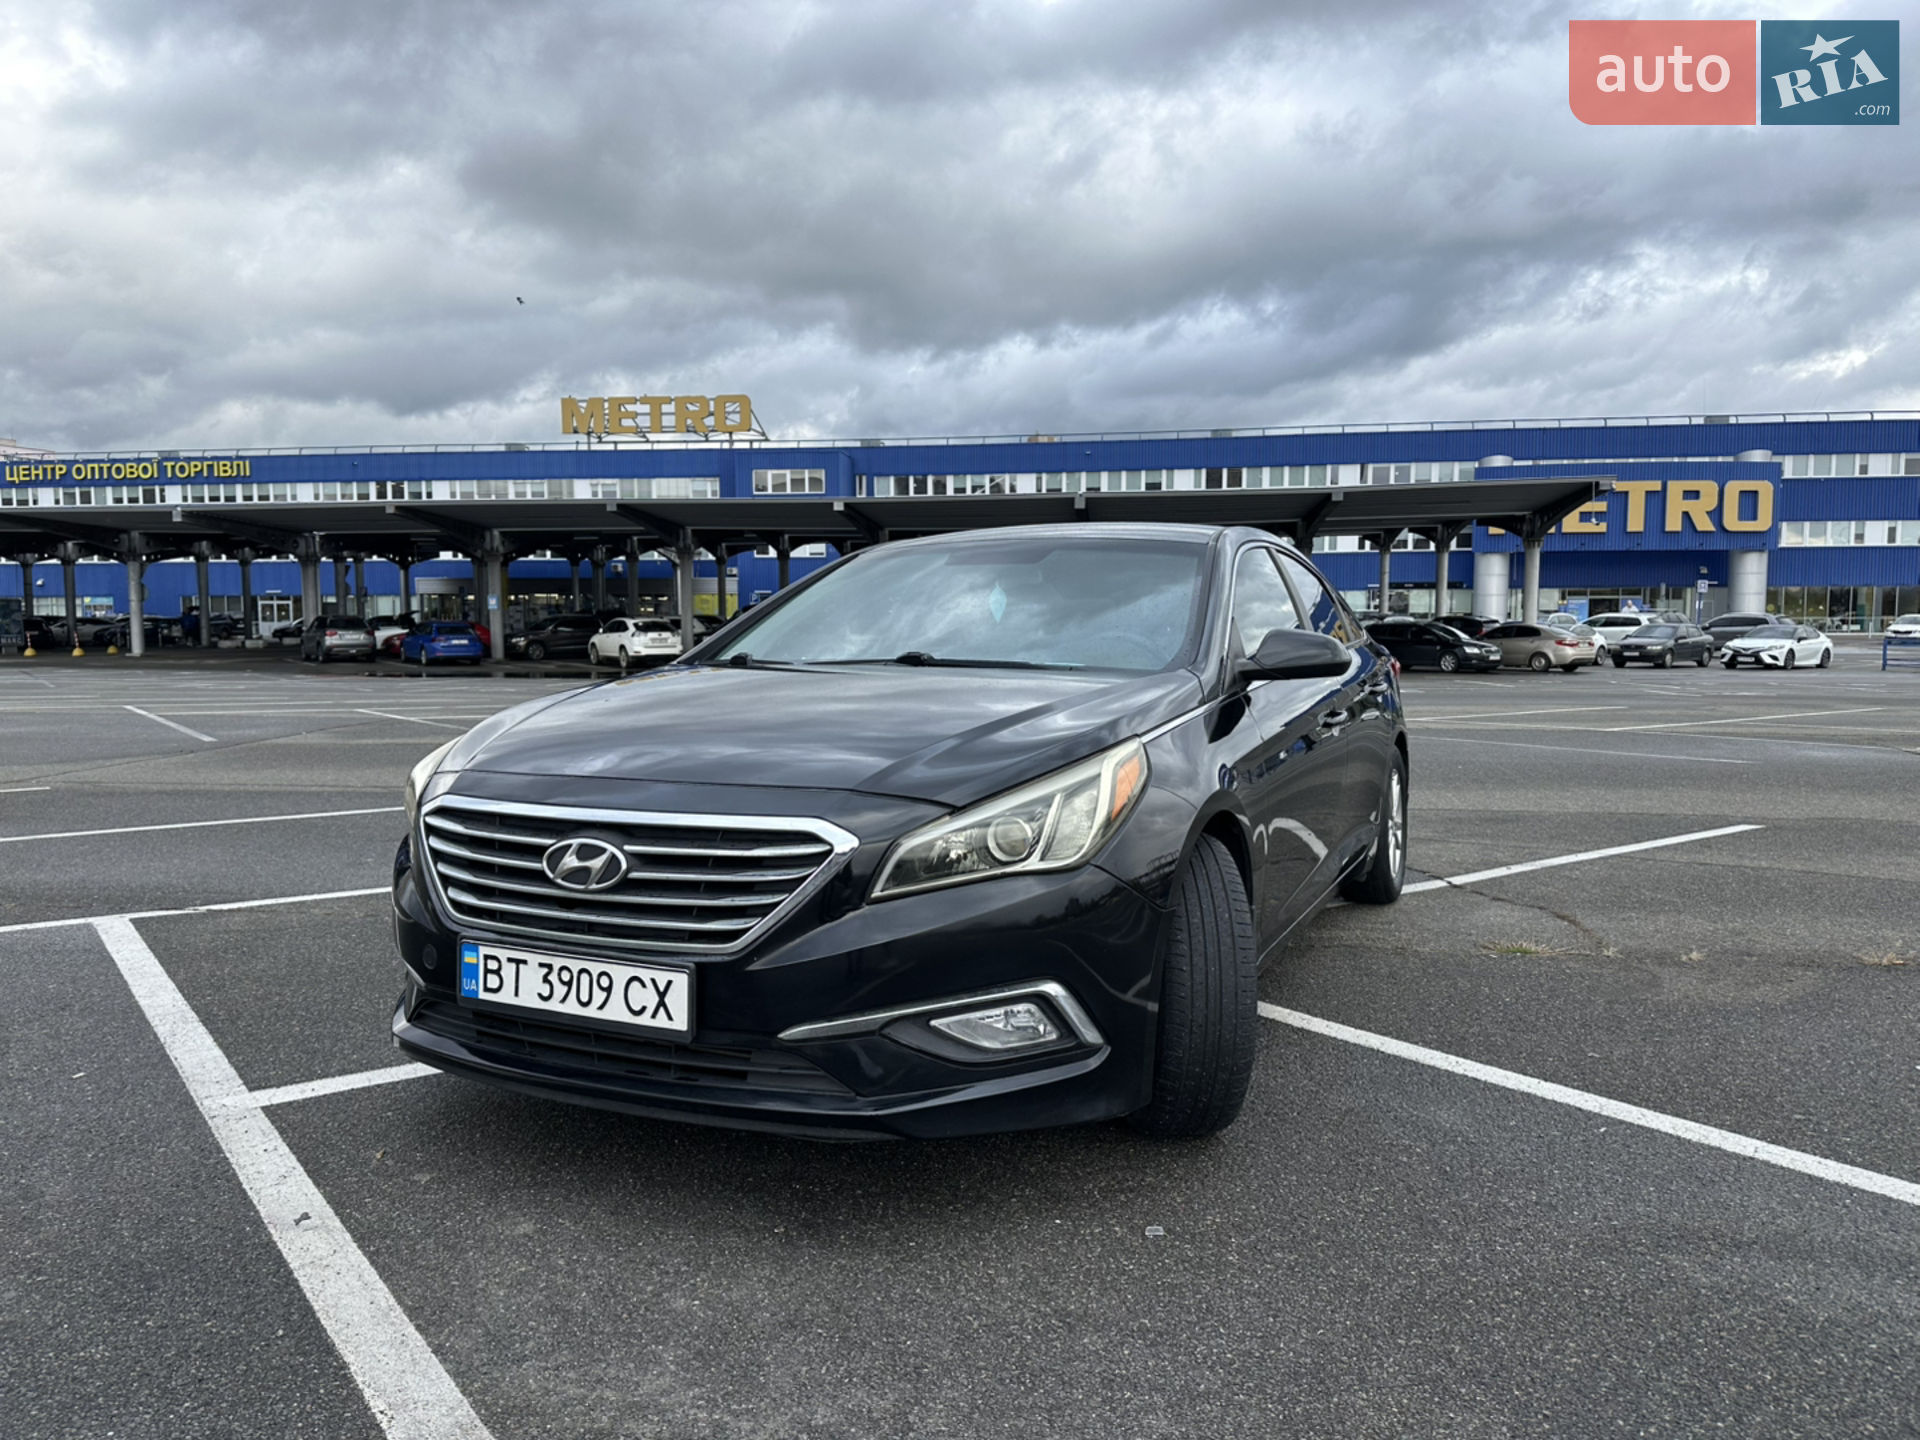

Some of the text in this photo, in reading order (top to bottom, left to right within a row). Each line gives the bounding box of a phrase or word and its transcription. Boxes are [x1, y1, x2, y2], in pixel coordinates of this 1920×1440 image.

[561, 394, 752, 434] METRO
[5, 459, 250, 484] ЦЕНТР ОПТОВОЇ ТОРГІВЛІ
[1488, 480, 1774, 534] ETRO
[463, 978, 477, 991] UA
[482, 953, 674, 1022] BT 3909 CX
